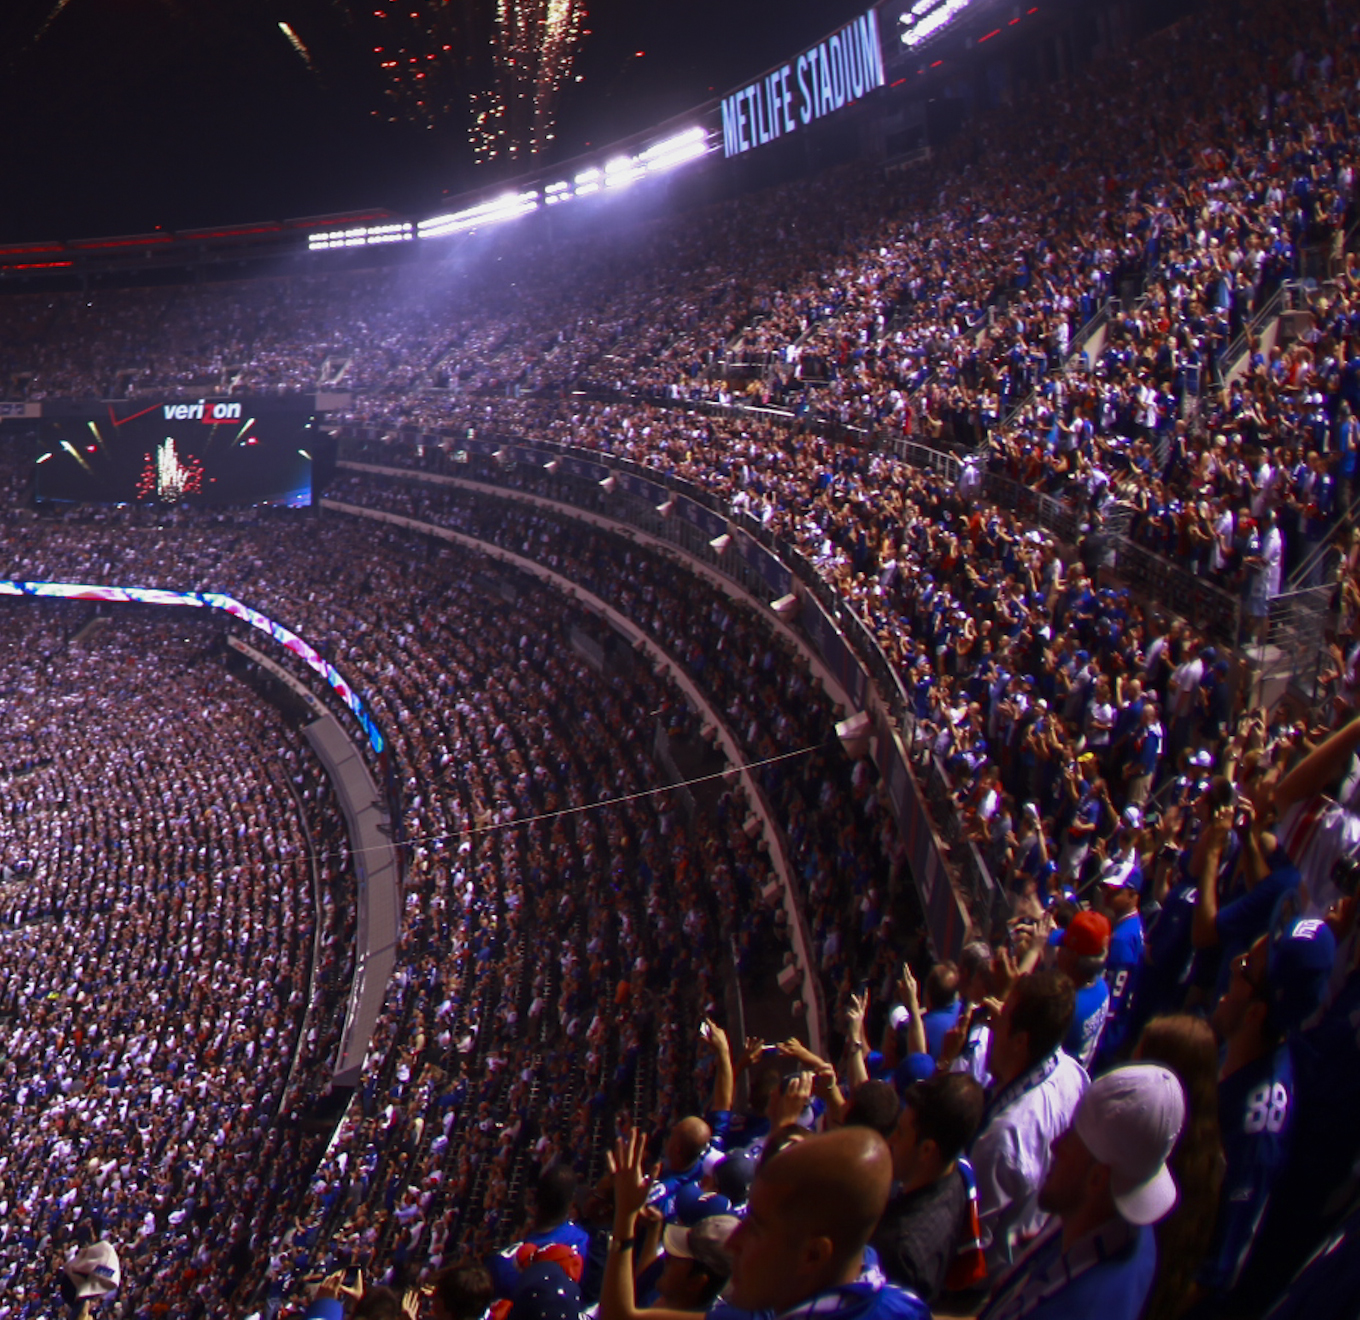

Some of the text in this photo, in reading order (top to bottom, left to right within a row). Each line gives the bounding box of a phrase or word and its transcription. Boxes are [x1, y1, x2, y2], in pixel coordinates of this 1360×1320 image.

[721, 9, 885, 159] METLIFE STADIUM
[164, 399, 241, 424] verizon
[1244, 1082, 1288, 1133] 88
